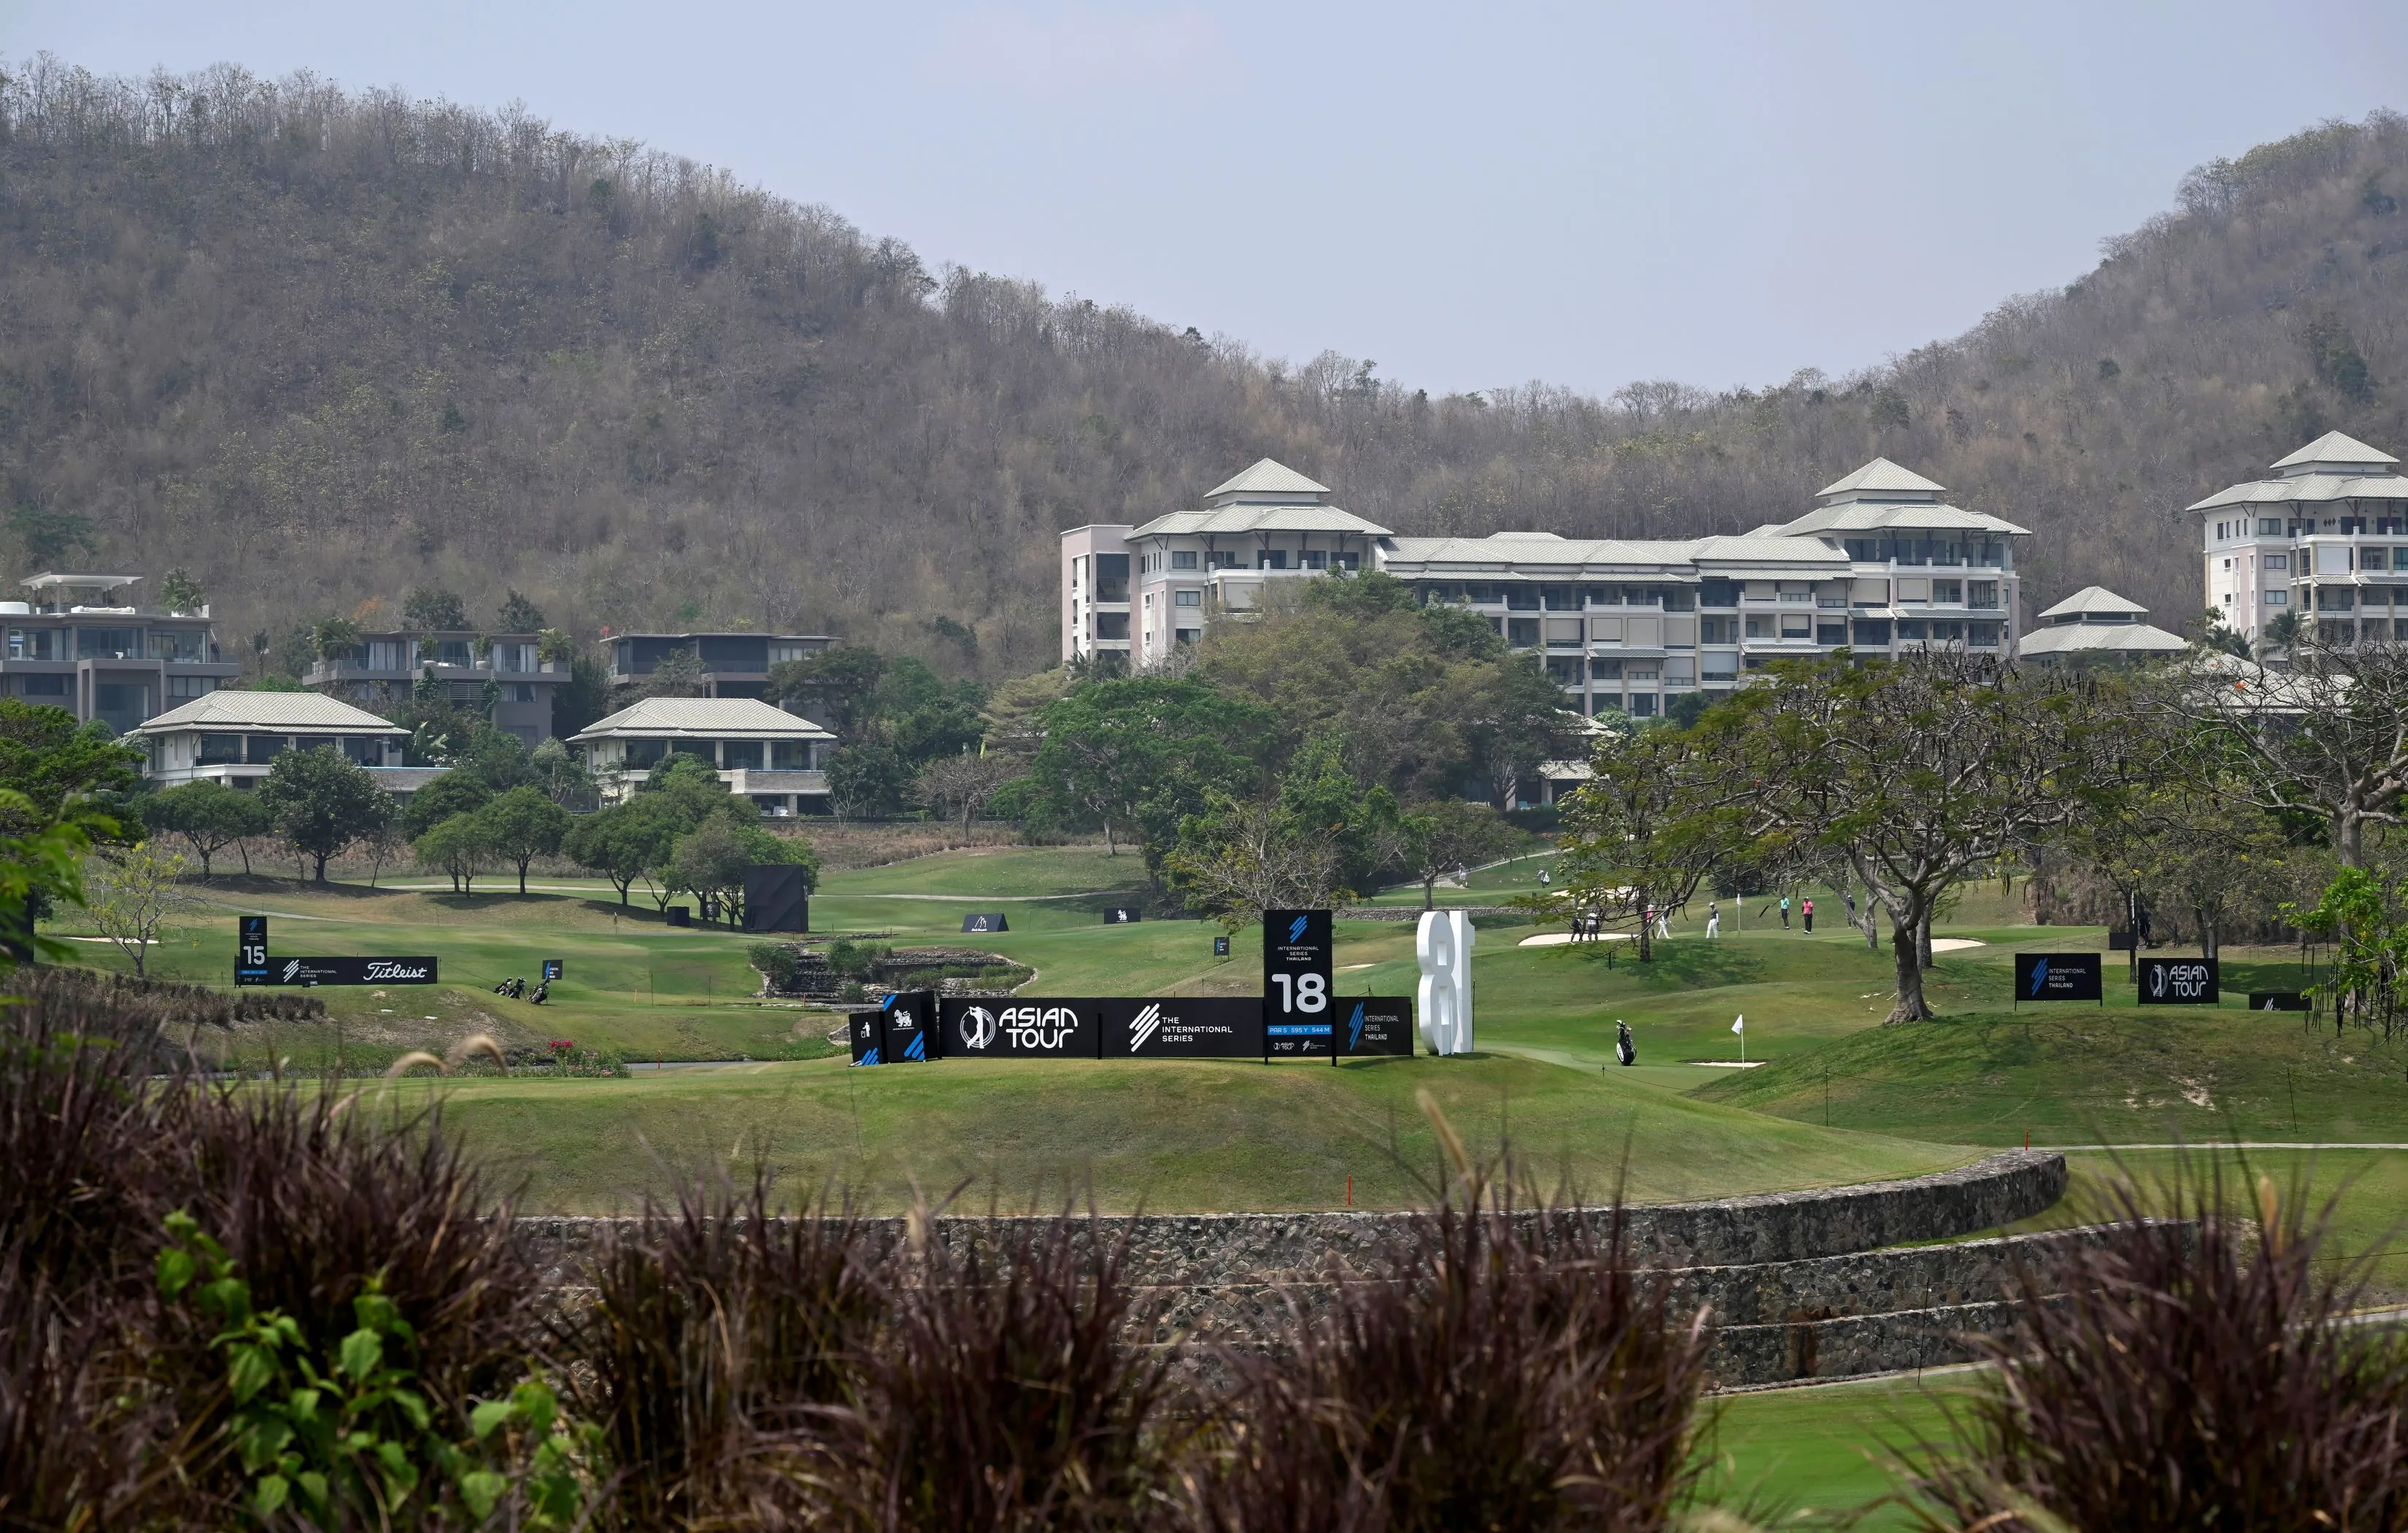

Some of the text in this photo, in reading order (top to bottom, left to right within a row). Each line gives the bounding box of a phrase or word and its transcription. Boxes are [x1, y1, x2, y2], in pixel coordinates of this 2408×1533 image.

[243, 946, 265, 965] 15
[363, 961, 428, 981] Titleist
[2169, 965, 2209, 981] ASIAN
[1271, 973, 1327, 1013] 18
[2172, 981, 2207, 997] TOUR
[998, 1007, 1078, 1027] ASIAN
[1006, 1028, 1074, 1049] TOUR
